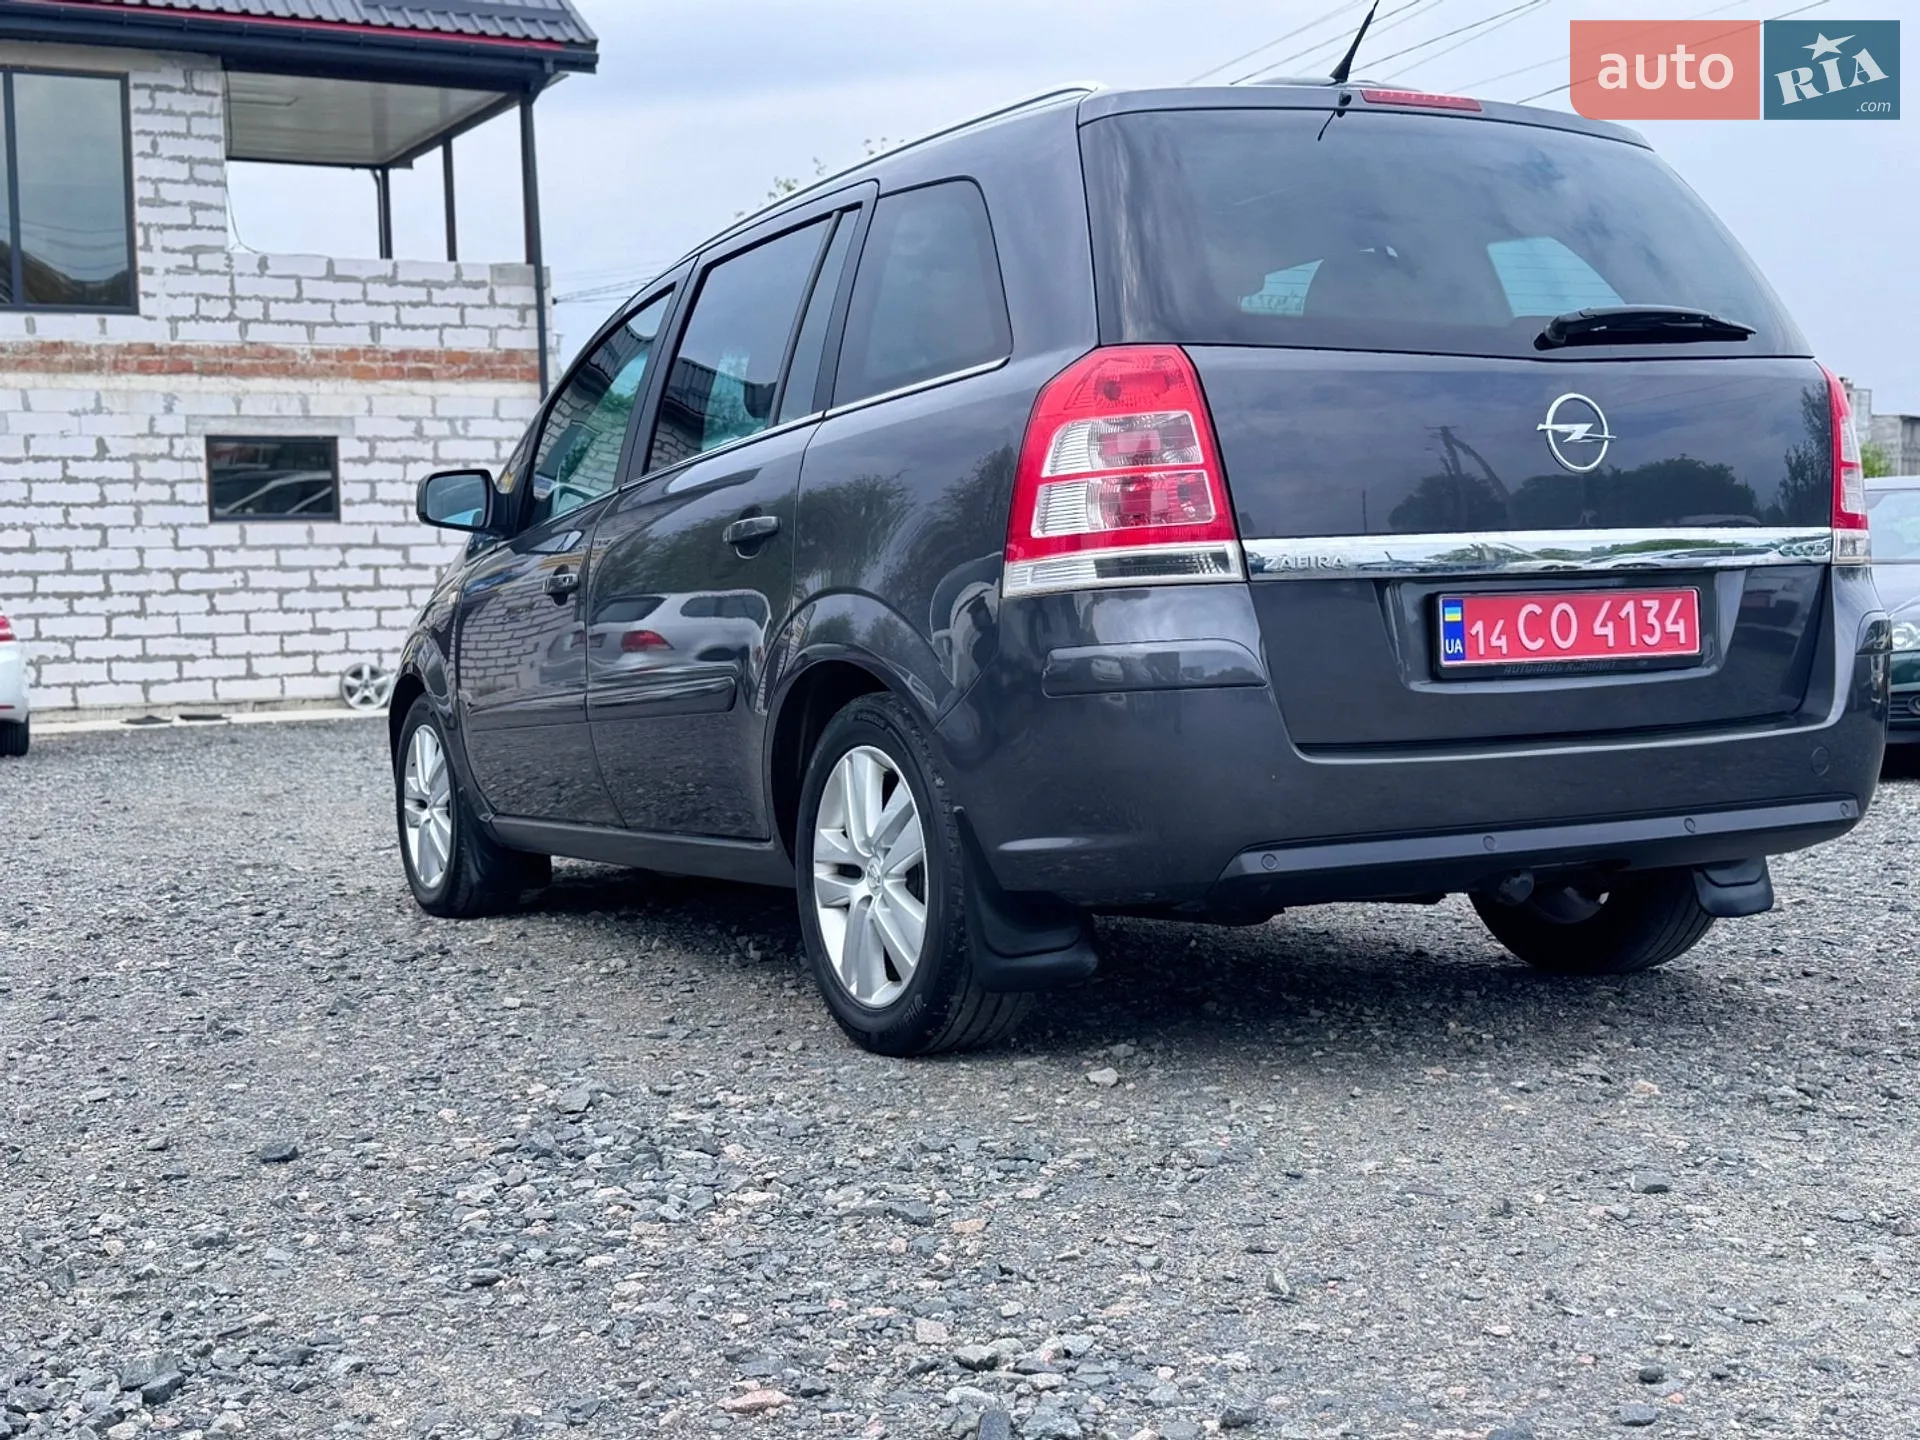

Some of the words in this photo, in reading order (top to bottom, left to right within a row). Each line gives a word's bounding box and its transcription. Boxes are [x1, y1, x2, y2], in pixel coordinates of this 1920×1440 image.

[1469, 619, 1507, 655] 14
[1517, 602, 1578, 651] CO
[1593, 598, 1686, 647] 4134
[1445, 638, 1463, 654] UA
